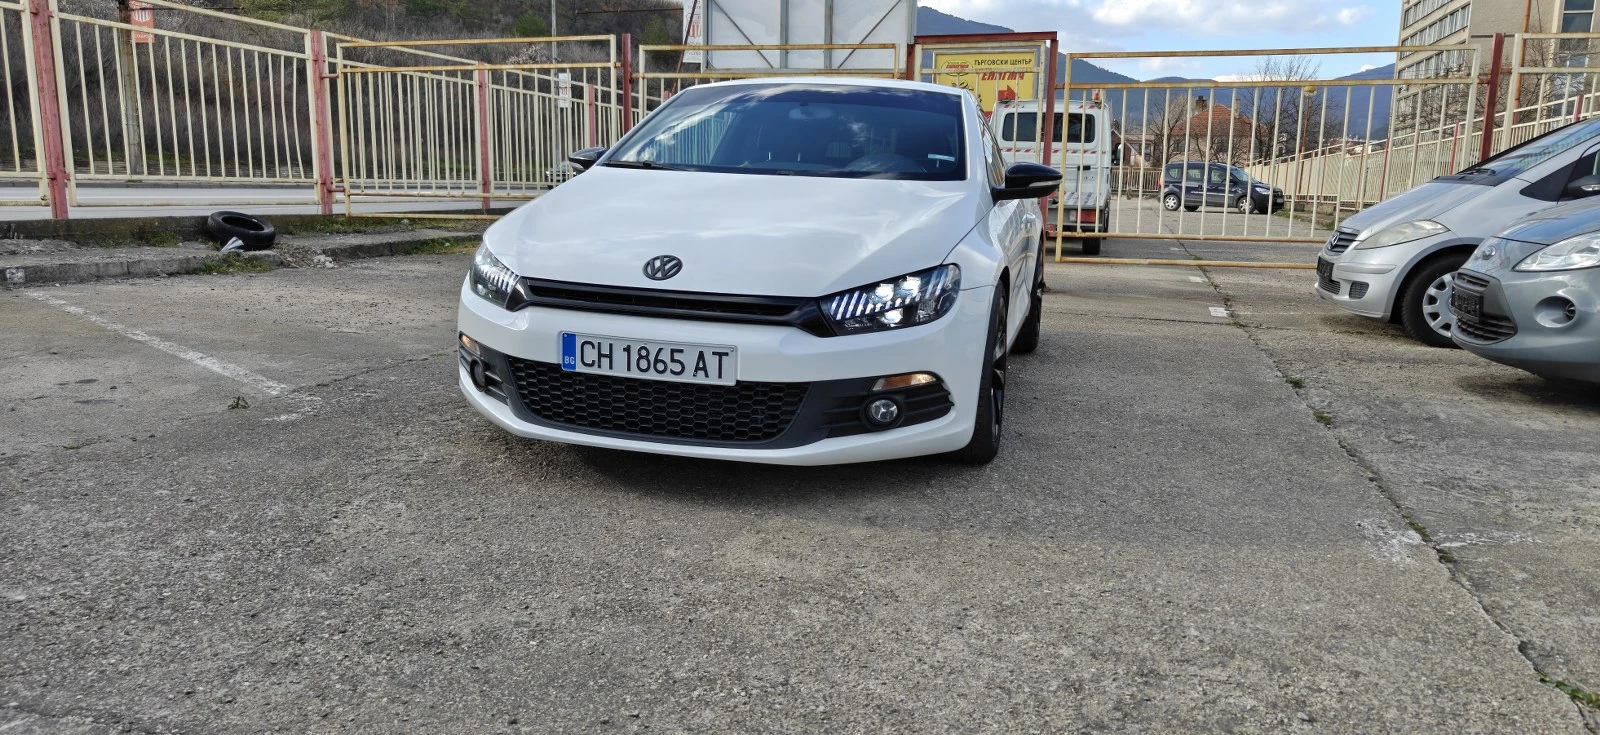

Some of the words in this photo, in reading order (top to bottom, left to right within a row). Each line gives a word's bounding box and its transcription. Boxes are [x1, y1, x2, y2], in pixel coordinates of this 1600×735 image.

[564, 355, 575, 365] BG
[580, 340, 613, 370] CH
[622, 344, 686, 376] 1865
[692, 350, 729, 379] AT
